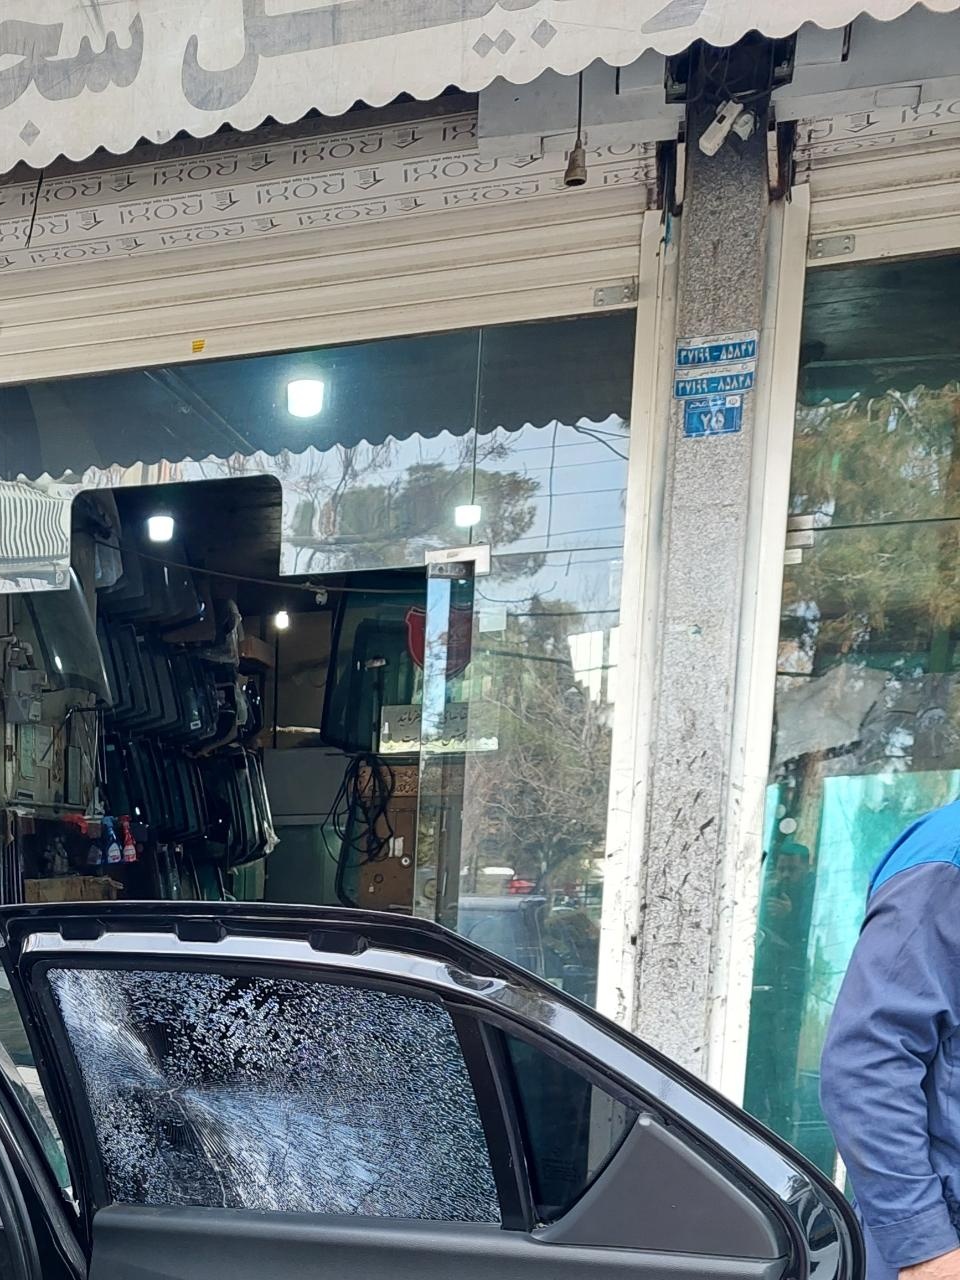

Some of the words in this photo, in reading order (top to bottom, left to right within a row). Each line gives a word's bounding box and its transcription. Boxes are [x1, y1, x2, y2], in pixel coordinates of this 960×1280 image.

[292, 137, 383, 165] ROXI
[152, 160, 238, 186] ROXI
[403, 157, 498, 183] ROXI
[257, 178, 345, 205] ROXI
[444, 184, 539, 206] ROXI
[120, 199, 203, 225] ROXI
[298, 204, 387, 226] ROXI
[160, 224, 245, 246] ROXI
[30, 244, 111, 264] ROXI
